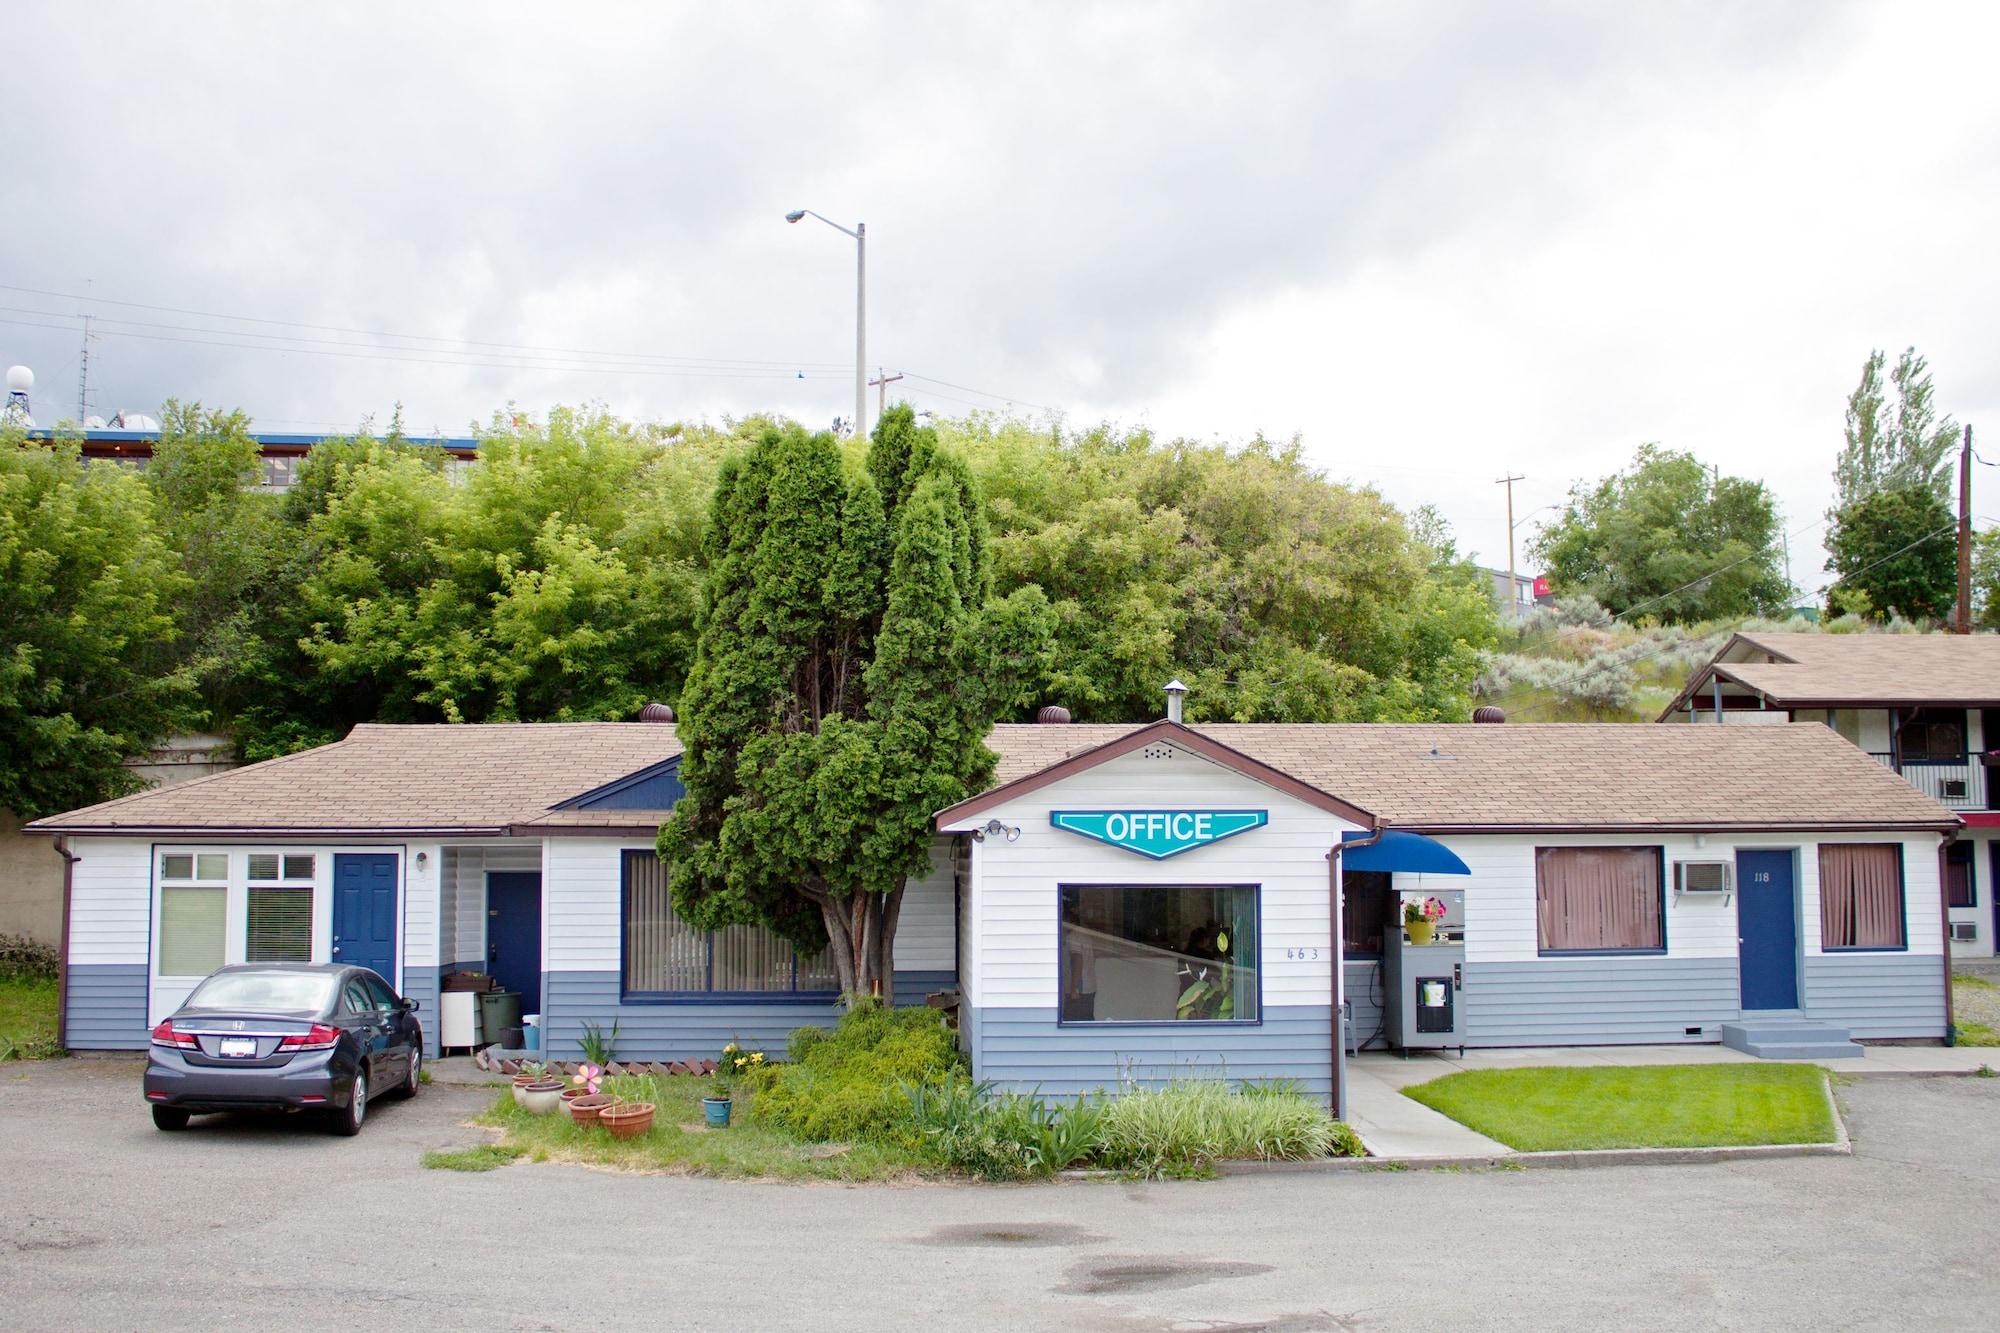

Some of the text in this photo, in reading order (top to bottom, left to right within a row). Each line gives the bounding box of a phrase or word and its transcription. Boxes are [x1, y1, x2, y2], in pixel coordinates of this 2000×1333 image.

[1106, 813, 1213, 840] OFFICE
[1754, 872, 1769, 882] 118
[1287, 947, 1318, 960] 463
